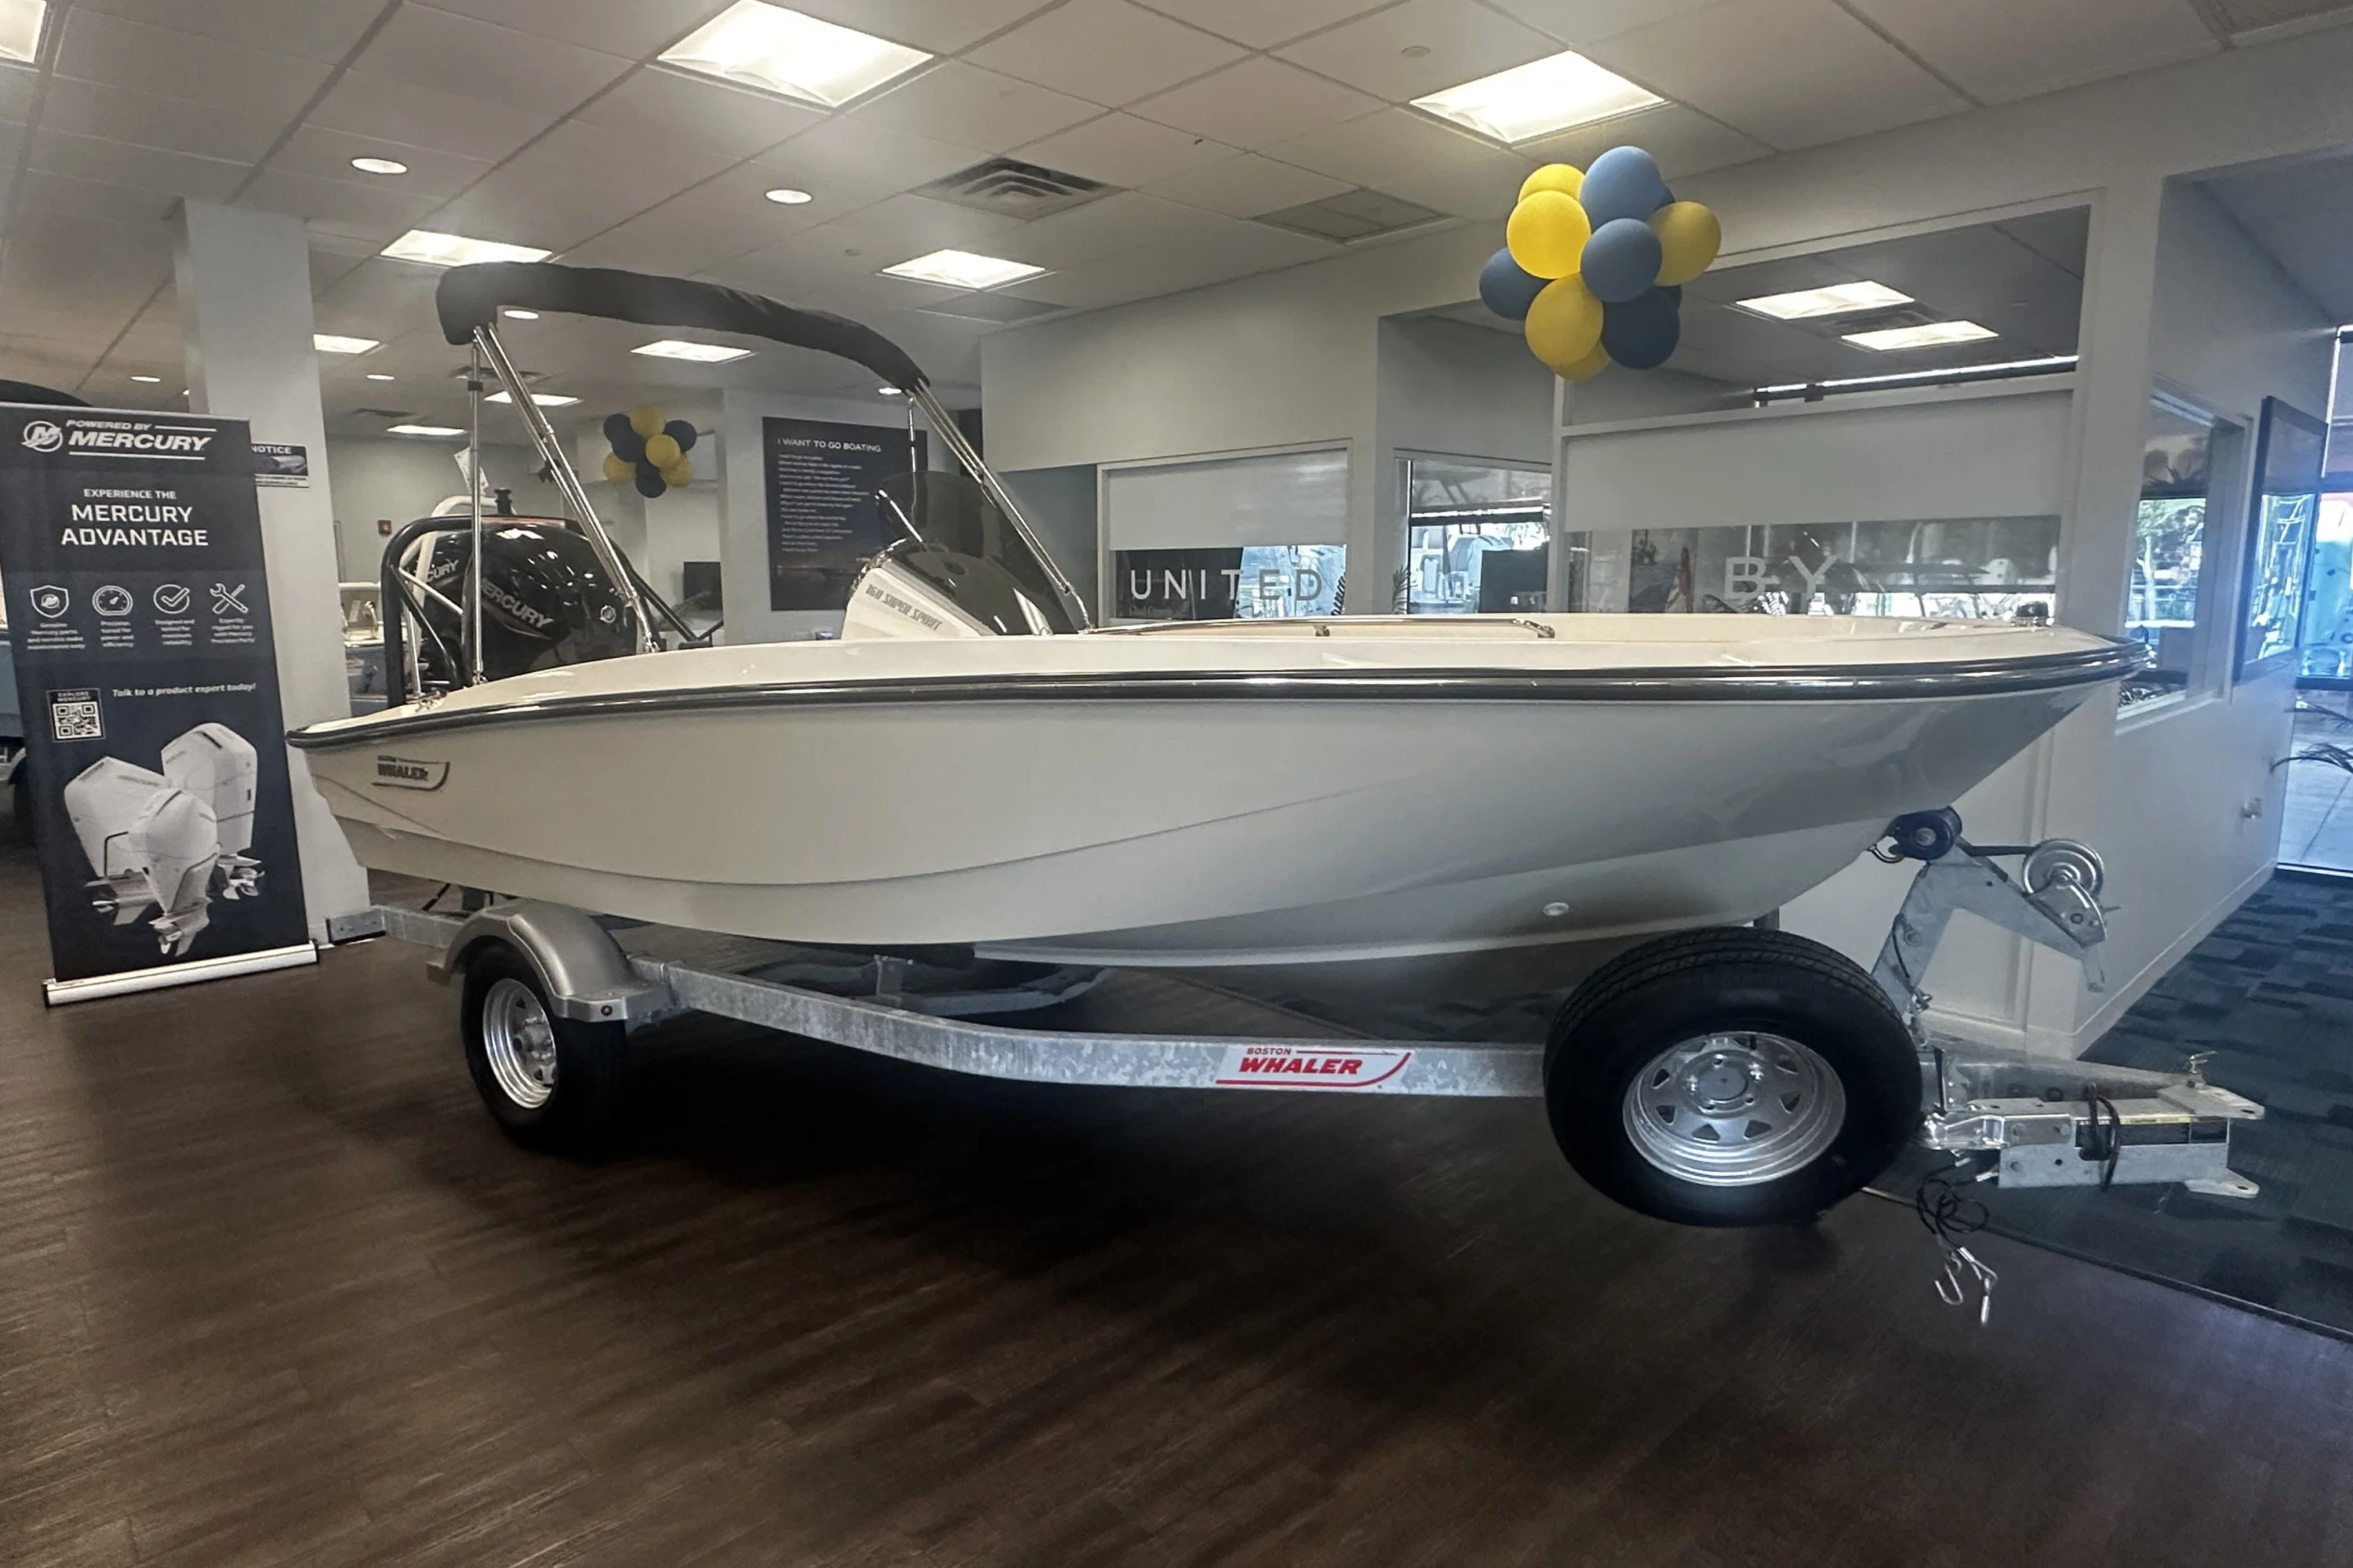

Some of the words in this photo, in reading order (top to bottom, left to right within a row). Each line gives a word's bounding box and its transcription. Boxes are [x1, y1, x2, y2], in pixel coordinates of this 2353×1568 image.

[66, 420, 131, 430] POWERED
[133, 422, 152, 431] BY
[68, 431, 211, 451] MERCURY
[827, 441, 842, 449] GO
[843, 442, 882, 452] BOATING
[83, 489, 152, 499] EXPERIENCE
[155, 490, 176, 500] THE
[71, 504, 193, 522] MERCURY
[61, 529, 209, 546] ADVANTAGE
[1130, 569, 1322, 602] UNITED
[1726, 555, 1838, 599] BY
[482, 577, 554, 628] ERCURY
[882, 593, 912, 616] SUPER
[910, 609, 943, 631] SPORT
[112, 689, 132, 697] Talk
[155, 686, 193, 697] product
[195, 684, 225, 693] expert
[227, 682, 256, 692] today!
[1239, 1057, 1362, 1074] WHALER
